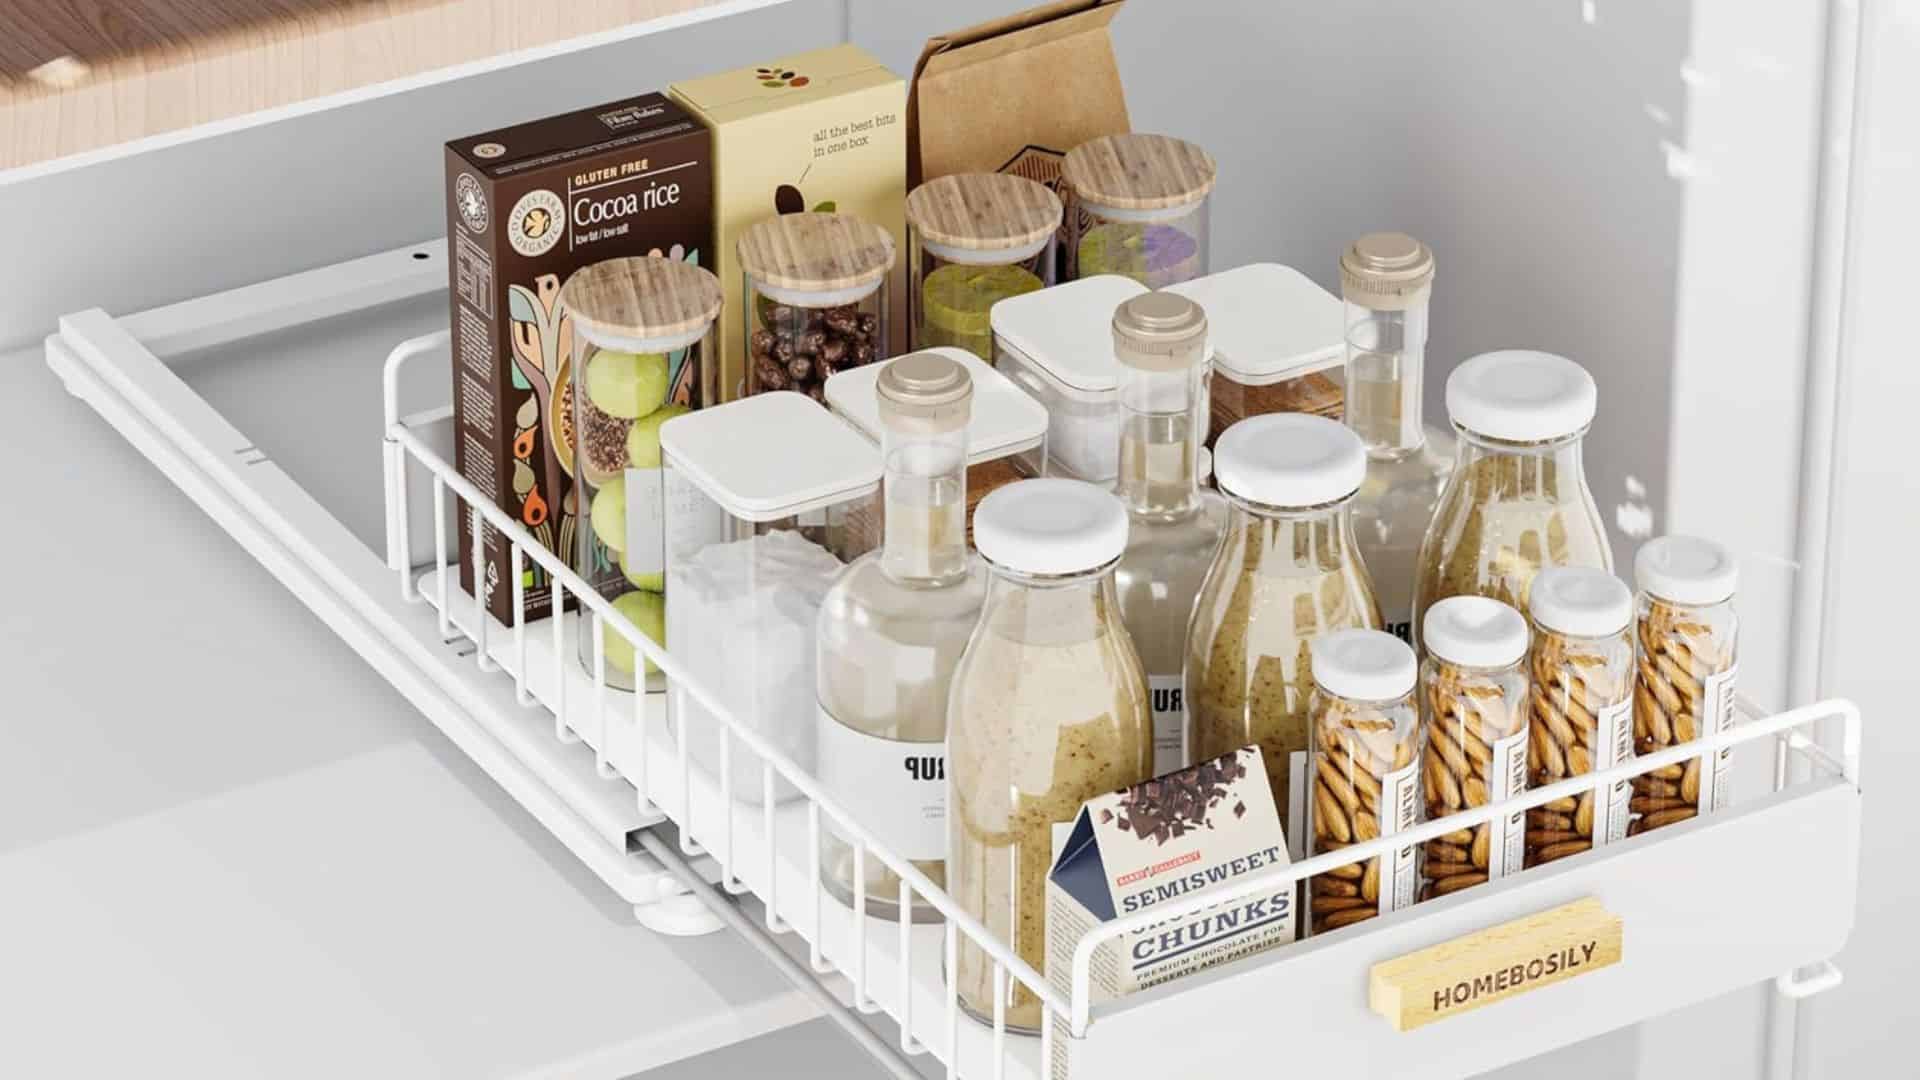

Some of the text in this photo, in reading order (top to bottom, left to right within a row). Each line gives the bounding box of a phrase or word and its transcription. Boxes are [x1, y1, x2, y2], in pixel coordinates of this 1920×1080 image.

[813, 114, 896, 142] all the best bits
[814, 135, 869, 158] in one box
[575, 158, 649, 186] GLUTEN FREE
[574, 181, 680, 226] Cocoa rice
[1123, 846, 1279, 913] SEMISWEET
[1132, 891, 1289, 960] CHUNKS
[1136, 924, 1285, 981] PREMIUM CHOCOLATE FOR
[1140, 936, 1281, 991] DESSERTS AND PASTRIES
[1433, 941, 1597, 1011] HOMEBOSILY
